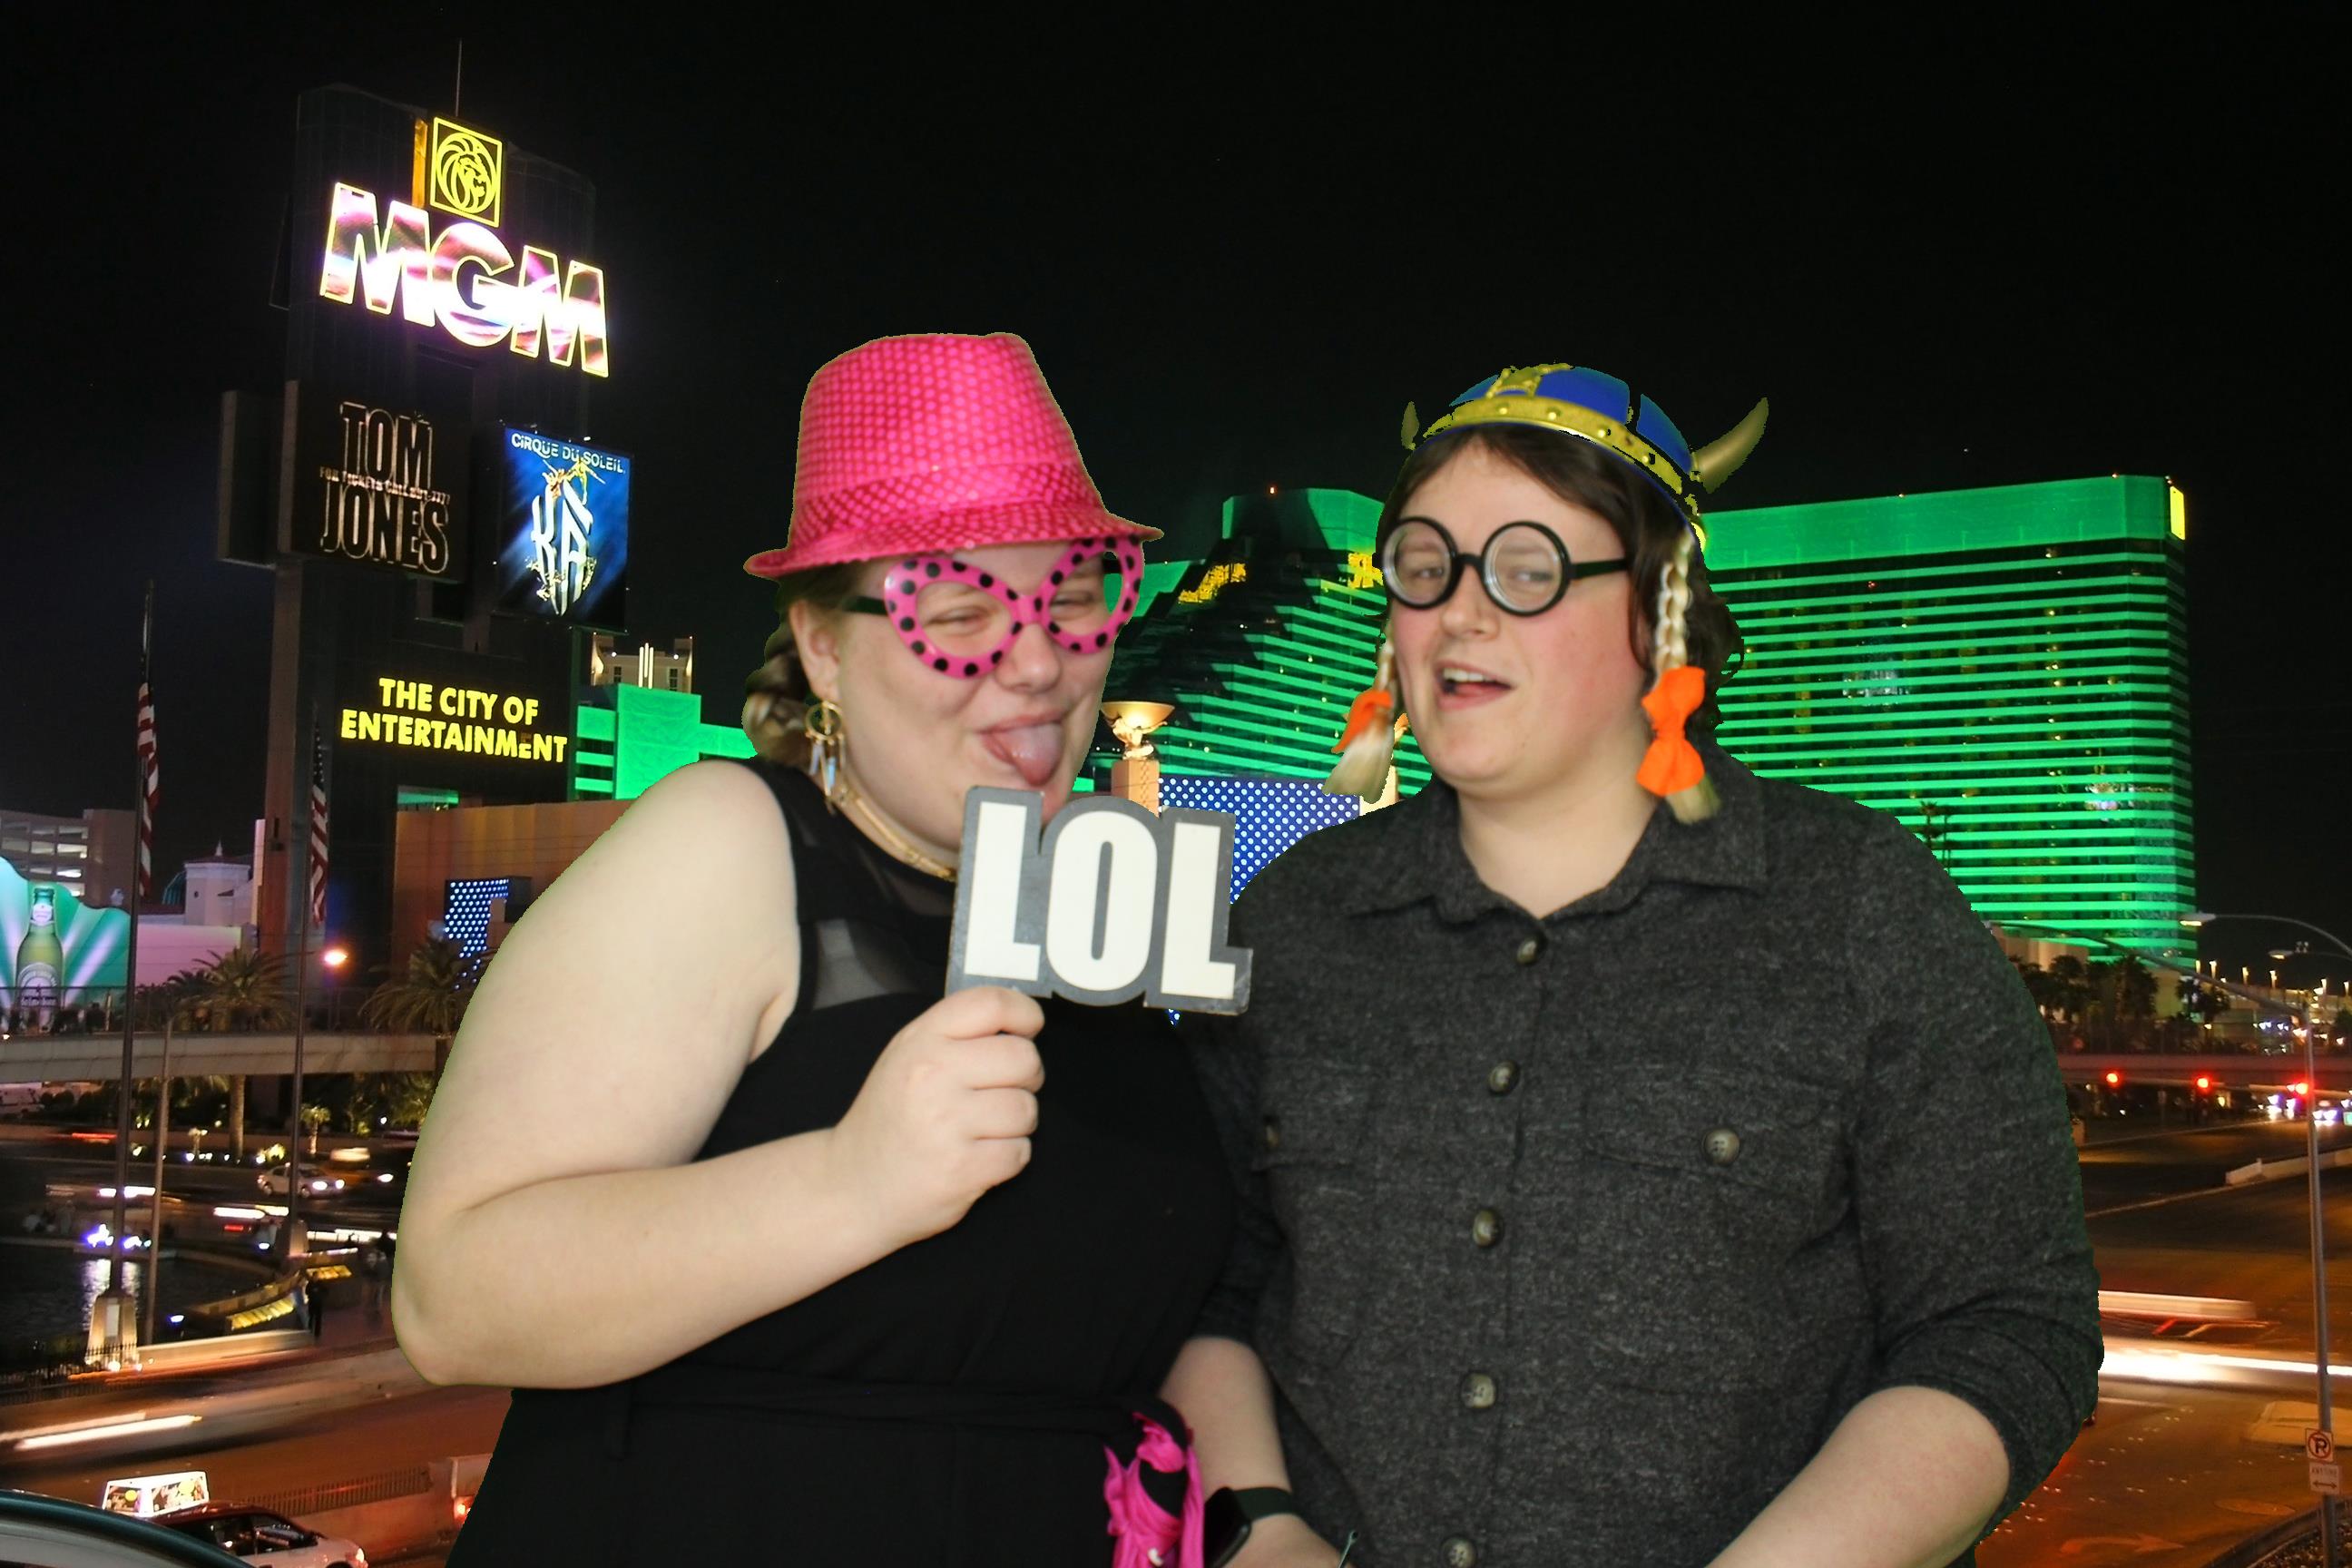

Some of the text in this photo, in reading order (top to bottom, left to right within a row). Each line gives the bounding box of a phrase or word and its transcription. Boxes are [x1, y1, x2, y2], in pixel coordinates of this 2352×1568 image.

[320, 182, 608, 377] MGM
[339, 401, 433, 491] TOM
[511, 433, 622, 474] CIRQUE DU SOLEIL
[319, 482, 449, 573] JONES
[340, 709, 567, 762] ENTERTAINMENT
[379, 678, 538, 725] THE CITY OF
[964, 801, 1236, 999] LOL
